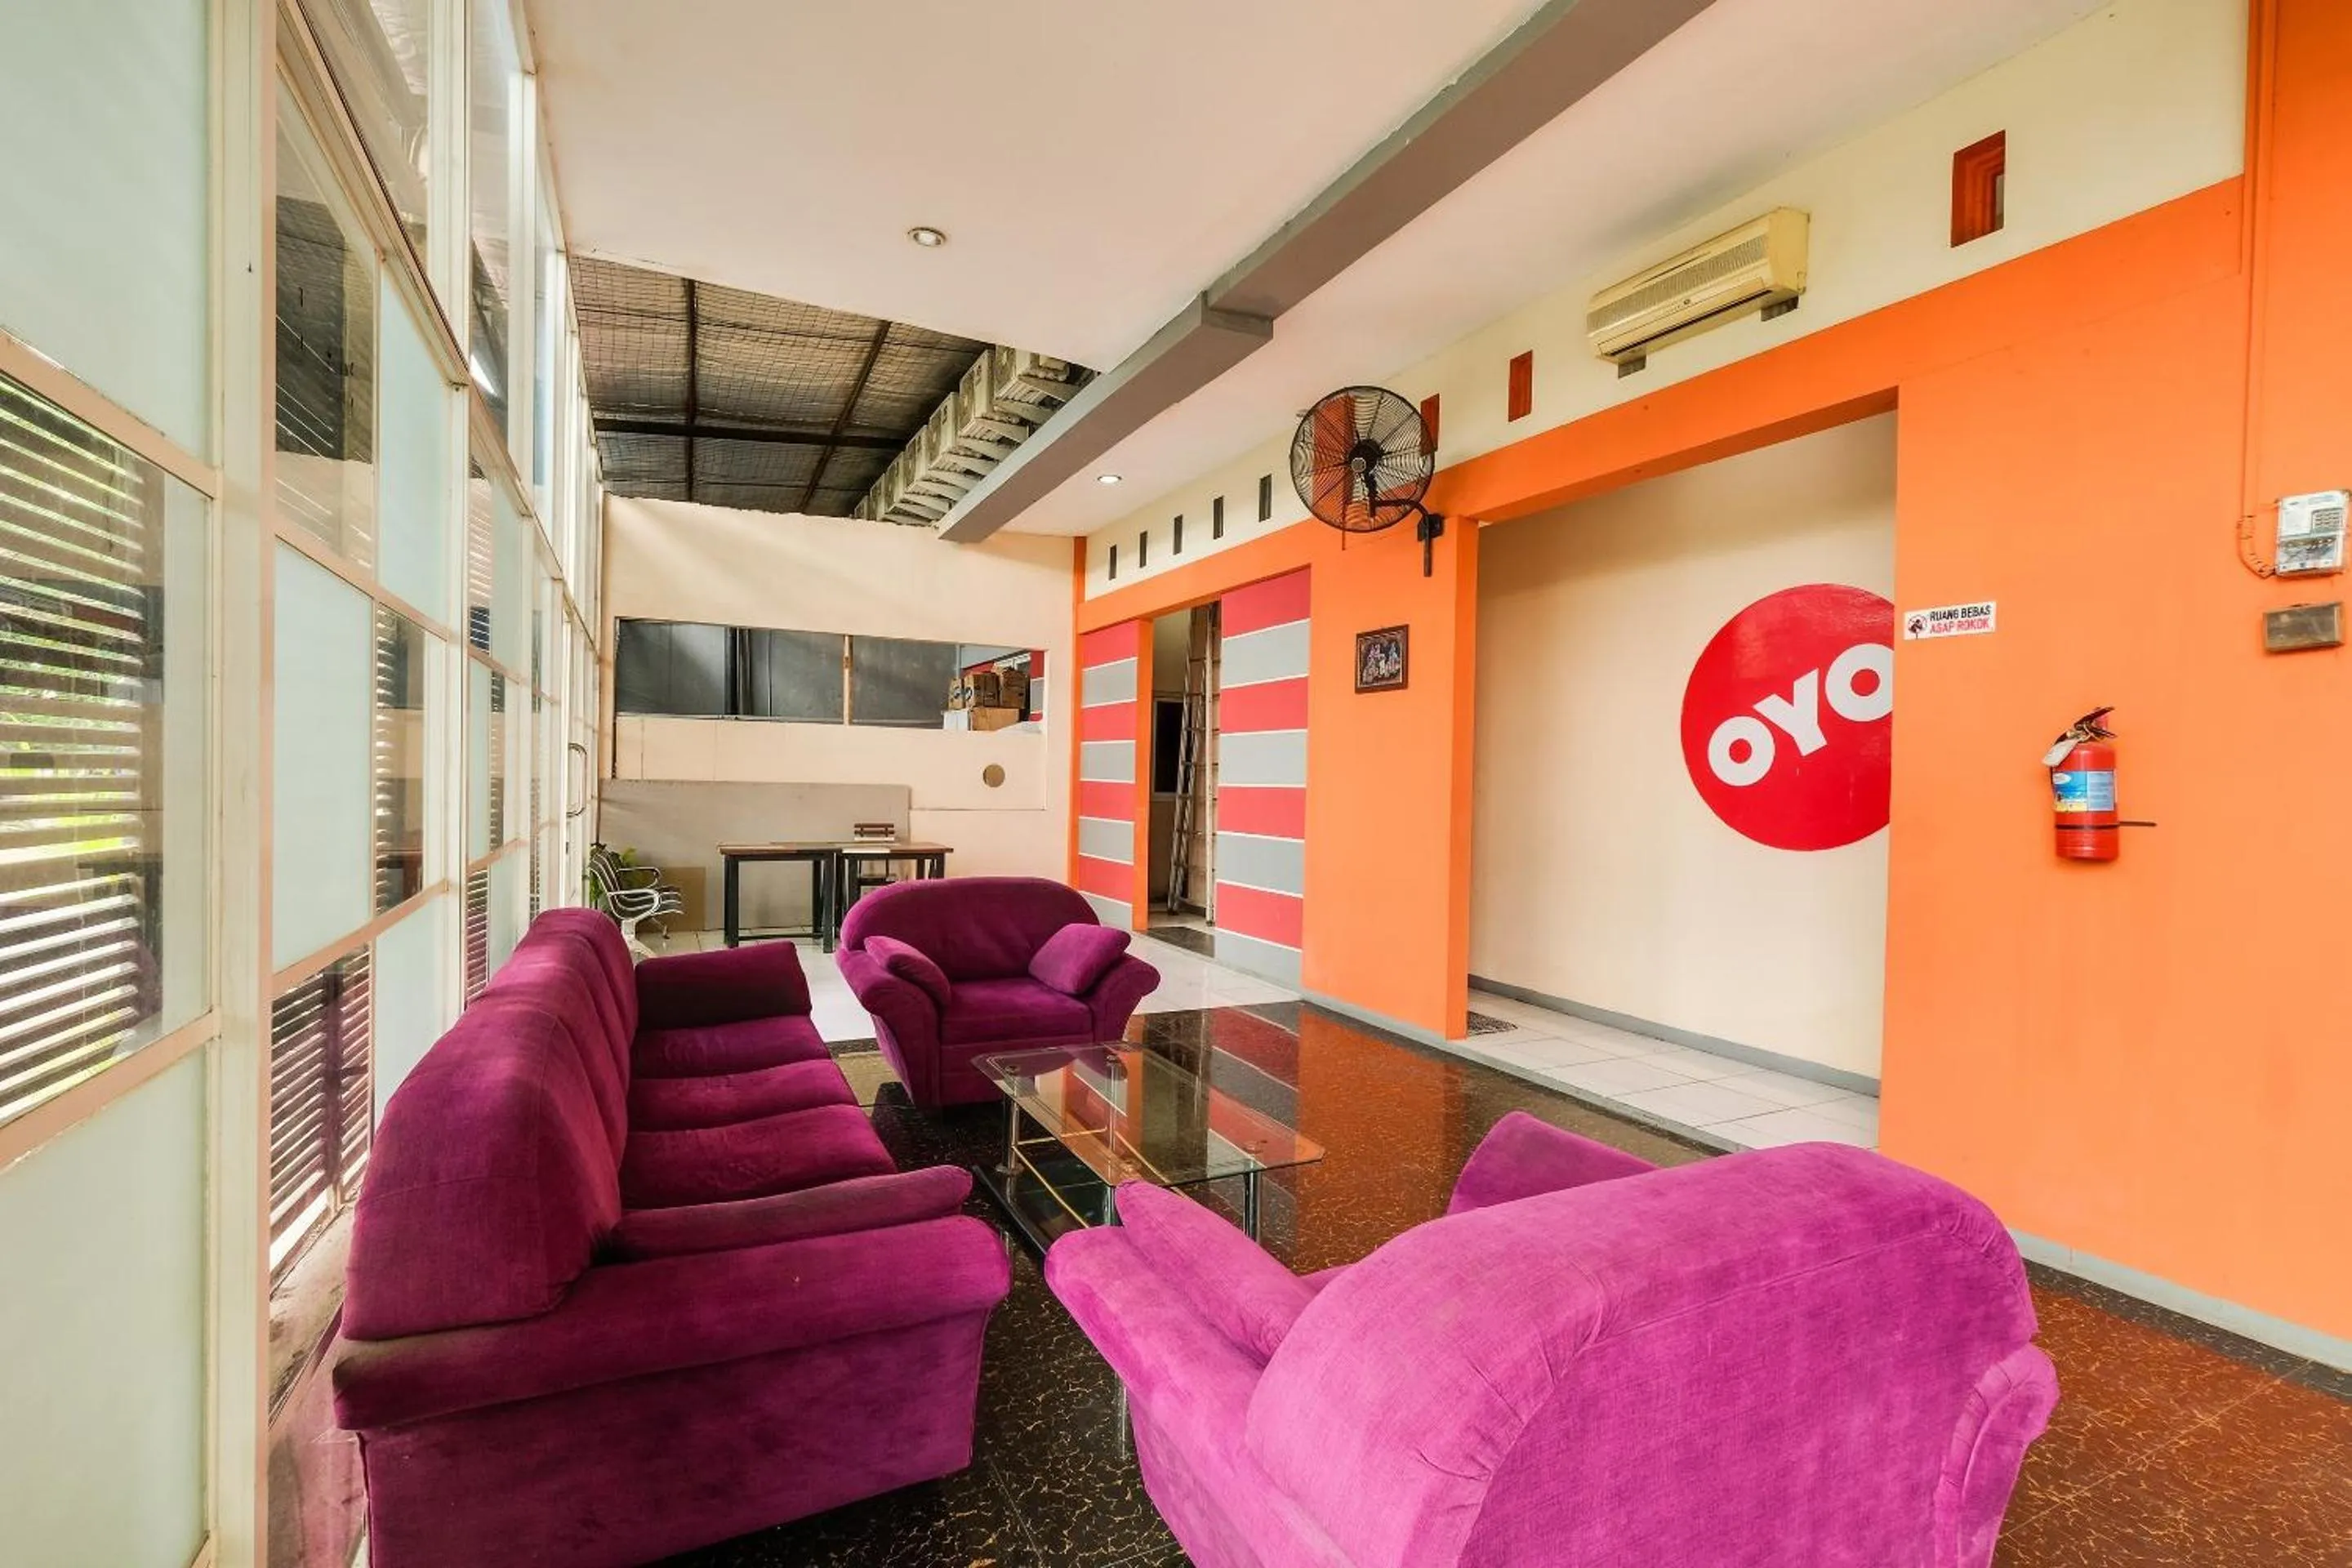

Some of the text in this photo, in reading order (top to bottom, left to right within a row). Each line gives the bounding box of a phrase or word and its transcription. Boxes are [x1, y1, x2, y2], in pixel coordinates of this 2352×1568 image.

[1930, 604, 1991, 621] RUANG BEBAS
[1930, 617, 1989, 634] ASAP ROKOK
[1708, 643, 1894, 786] OYO
